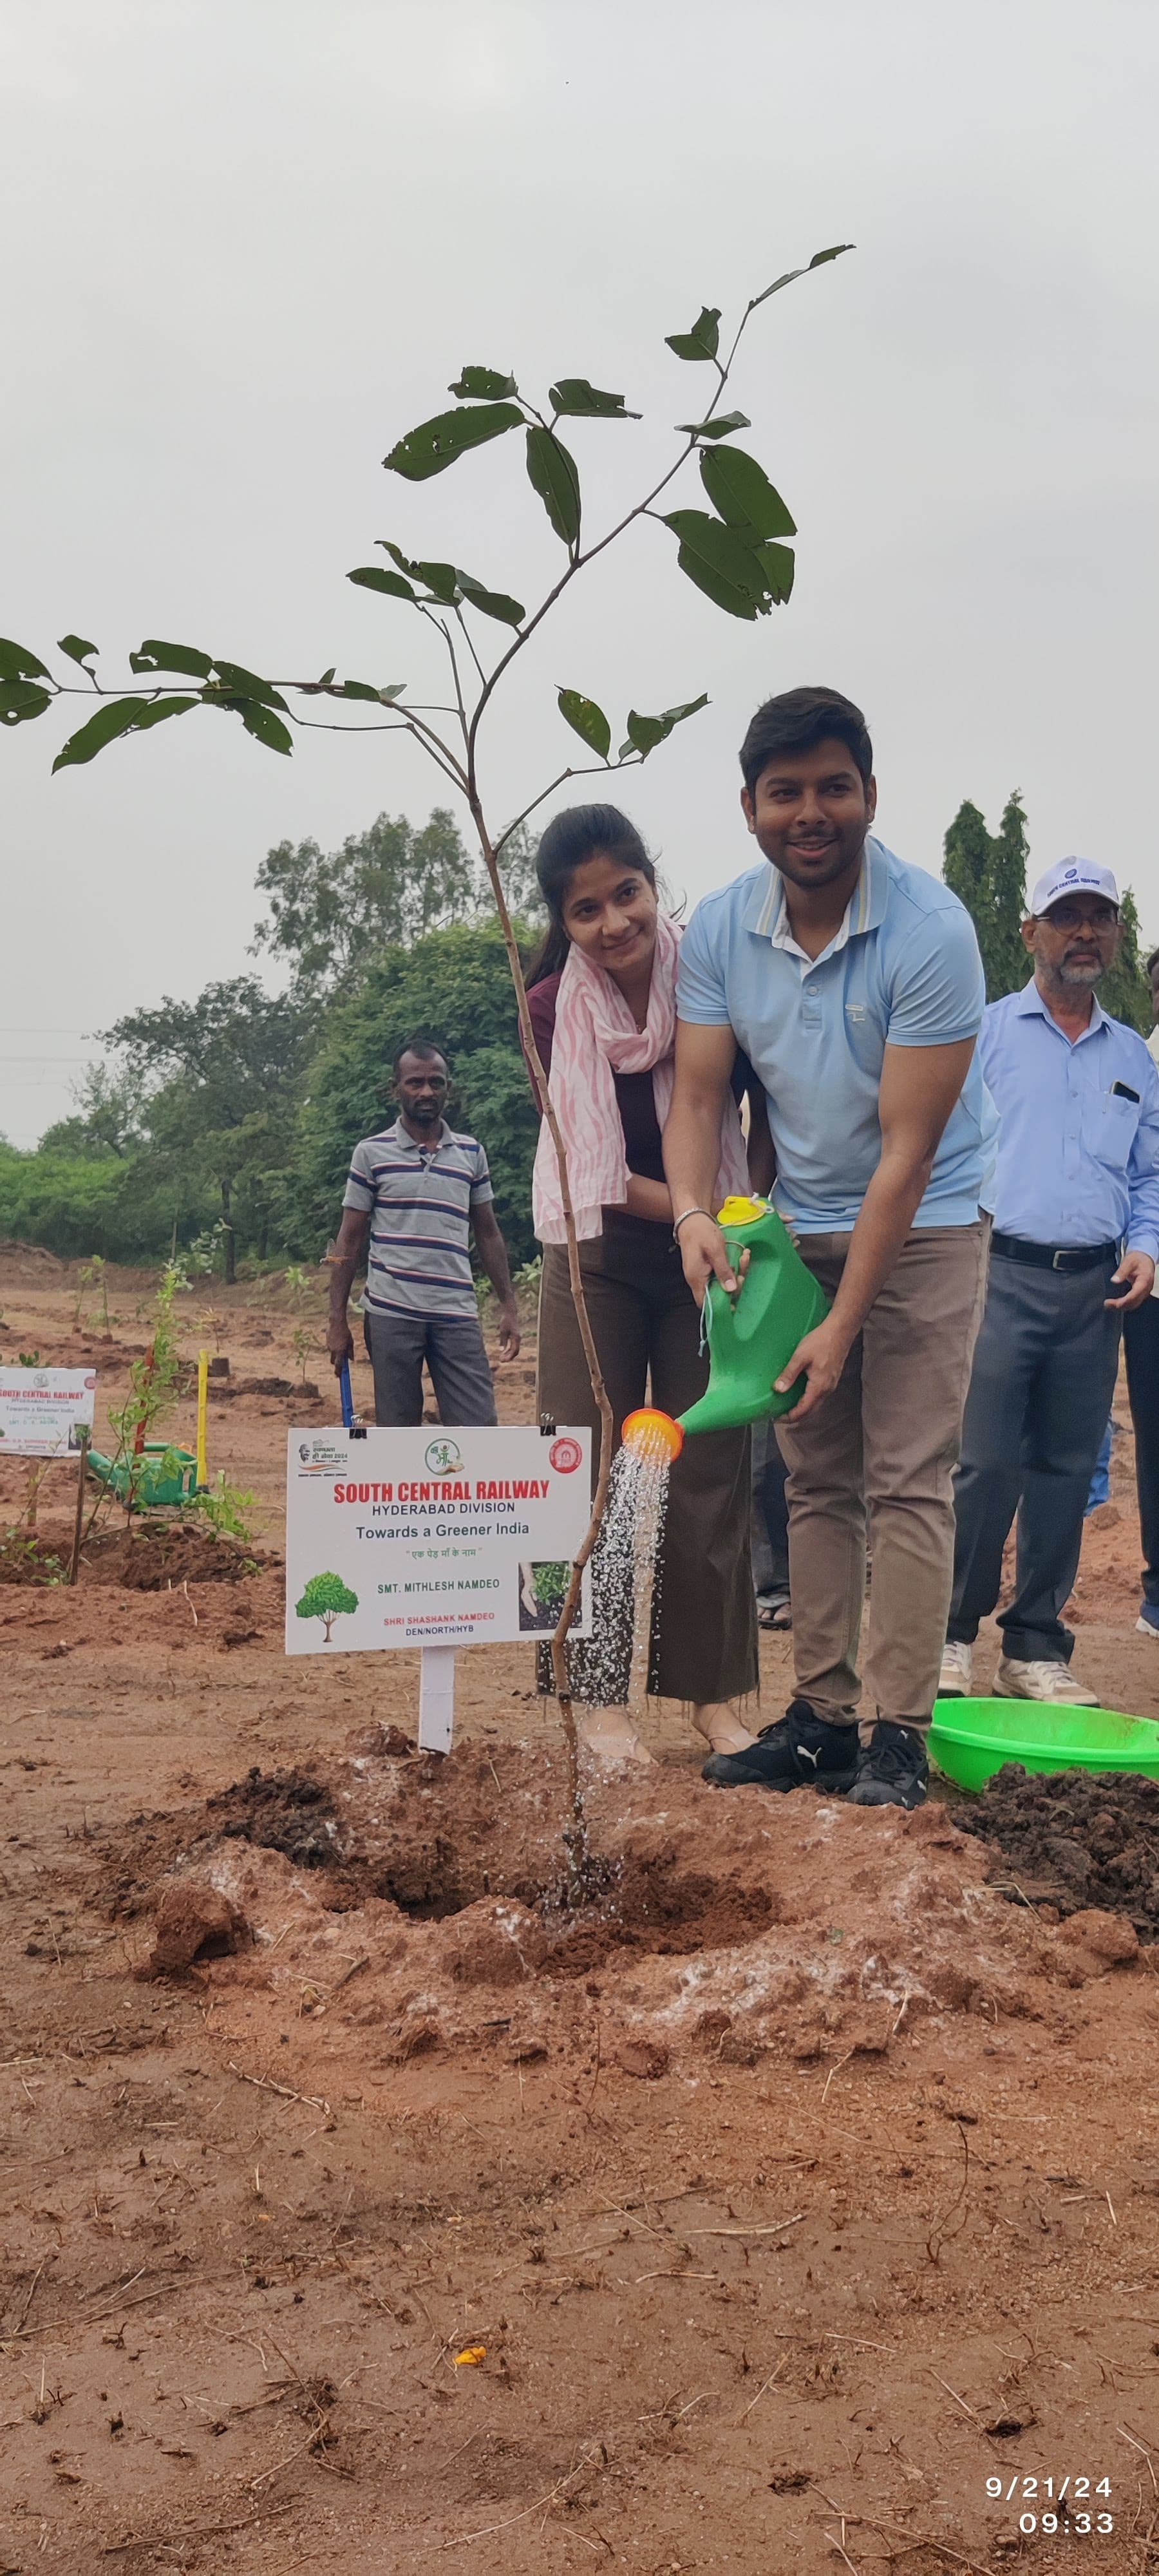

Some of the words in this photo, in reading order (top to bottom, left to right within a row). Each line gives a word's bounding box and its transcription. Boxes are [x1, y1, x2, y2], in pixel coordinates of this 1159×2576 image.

[23, 1390, 52, 1399] CENTRAL
[53, 1391, 84, 1400] RAILWAY
[334, 1482, 393, 1504] SOUTH
[397, 1481, 472, 1502] CENTRAL
[476, 1480, 550, 1500] RAILWAY
[372, 1504, 456, 1516] HYDERABAD
[460, 1502, 515, 1514] DIVISION
[356, 1524, 419, 1539] Towards
[423, 1528, 431, 1537] a
[435, 1523, 492, 1537] Greener
[496, 1522, 529, 1535] India
[452, 1547, 460, 1557] के
[377, 1583, 401, 1594] SMT.
[404, 1581, 455, 1593] MITHLESH
[458, 1578, 500, 1590] NAMDEO
[384, 1617, 404, 1626] SHRI
[407, 1615, 455, 1624] SHASHANK
[458, 1612, 495, 1622] NAMDEO
[406, 1624, 474, 1636] DEN/NORTH/HYB
